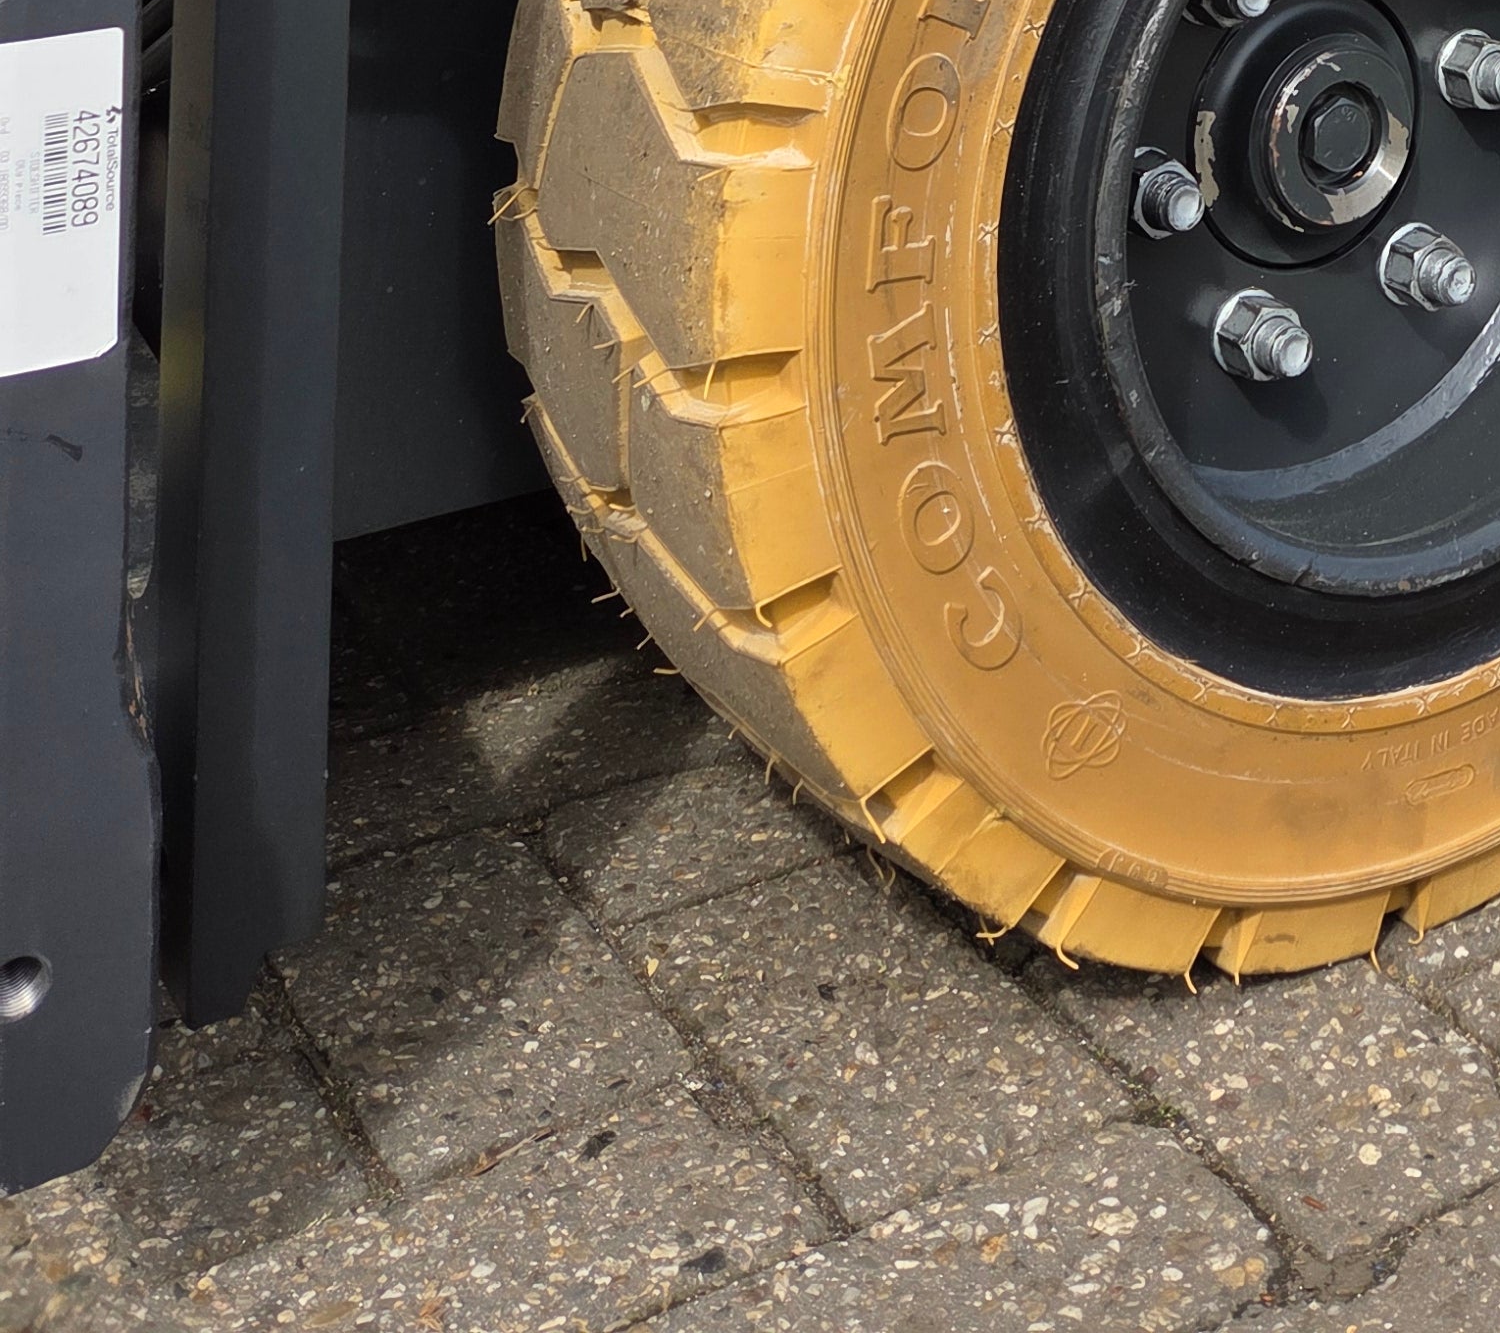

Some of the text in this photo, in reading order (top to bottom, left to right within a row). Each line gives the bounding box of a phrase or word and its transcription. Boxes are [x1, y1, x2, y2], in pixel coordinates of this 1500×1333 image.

[71, 109, 101, 228] 42674089
[105, 124, 119, 212] TotalSource
[1360, 740, 1420, 772] ITALY
[1430, 729, 1450, 757] IN
